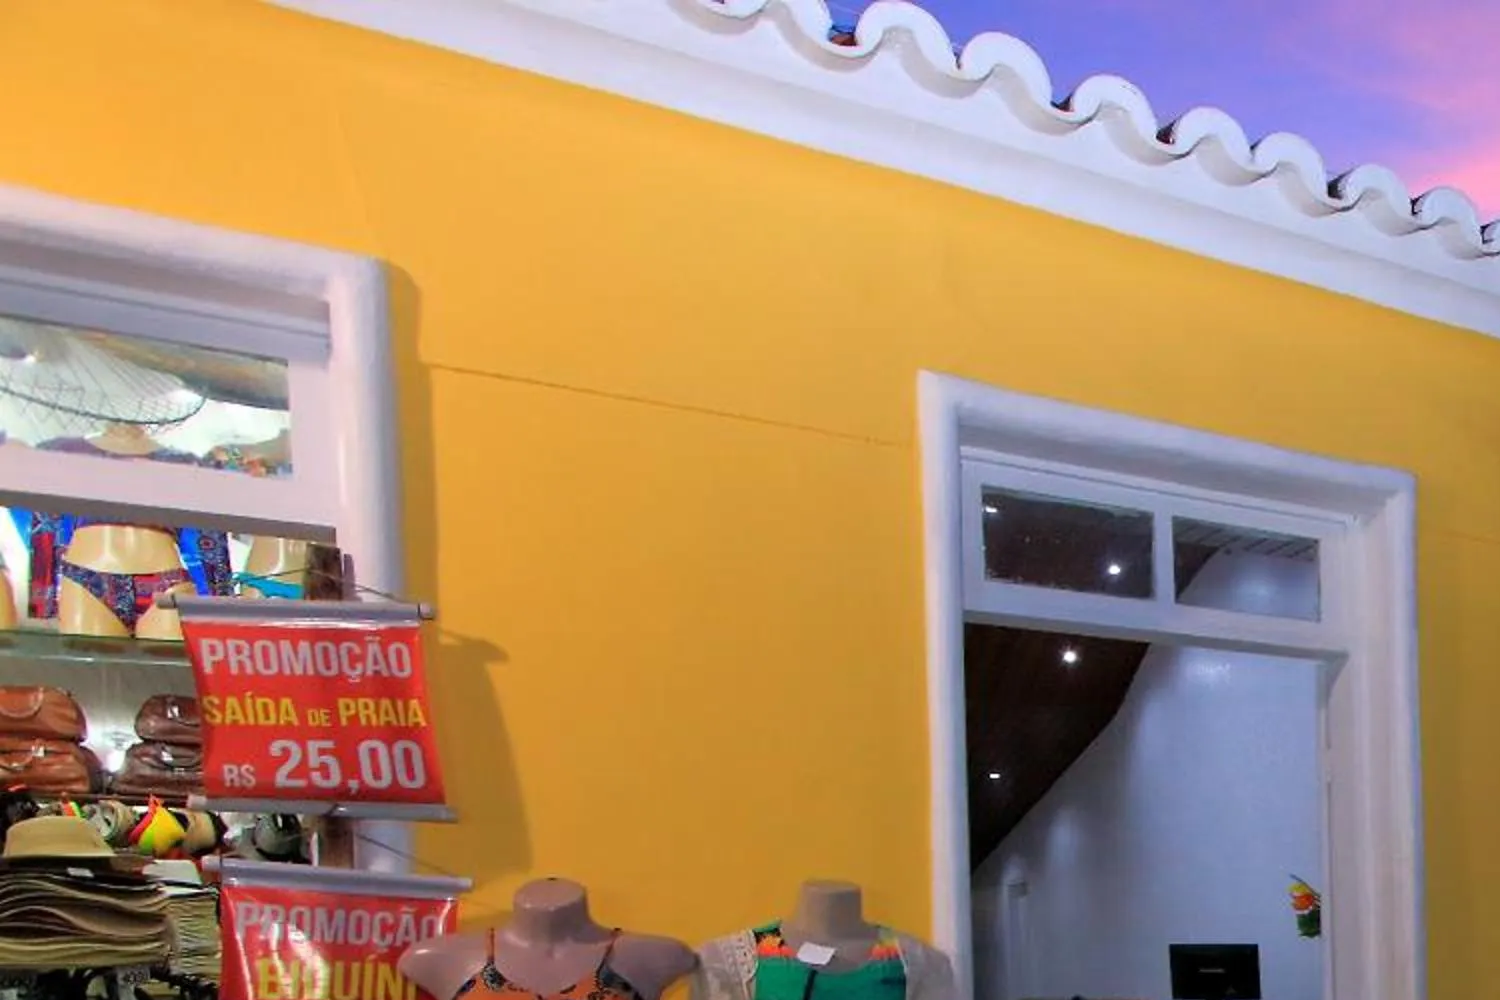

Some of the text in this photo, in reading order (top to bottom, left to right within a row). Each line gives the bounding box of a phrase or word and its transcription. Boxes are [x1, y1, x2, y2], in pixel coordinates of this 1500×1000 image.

[199, 636, 413, 683] PROMOÇÃO
[203, 692, 428, 728] SAÍDA DE PRAIA
[269, 738, 427, 795] 25,00
[235, 901, 442, 952] PROMOÇÃO
